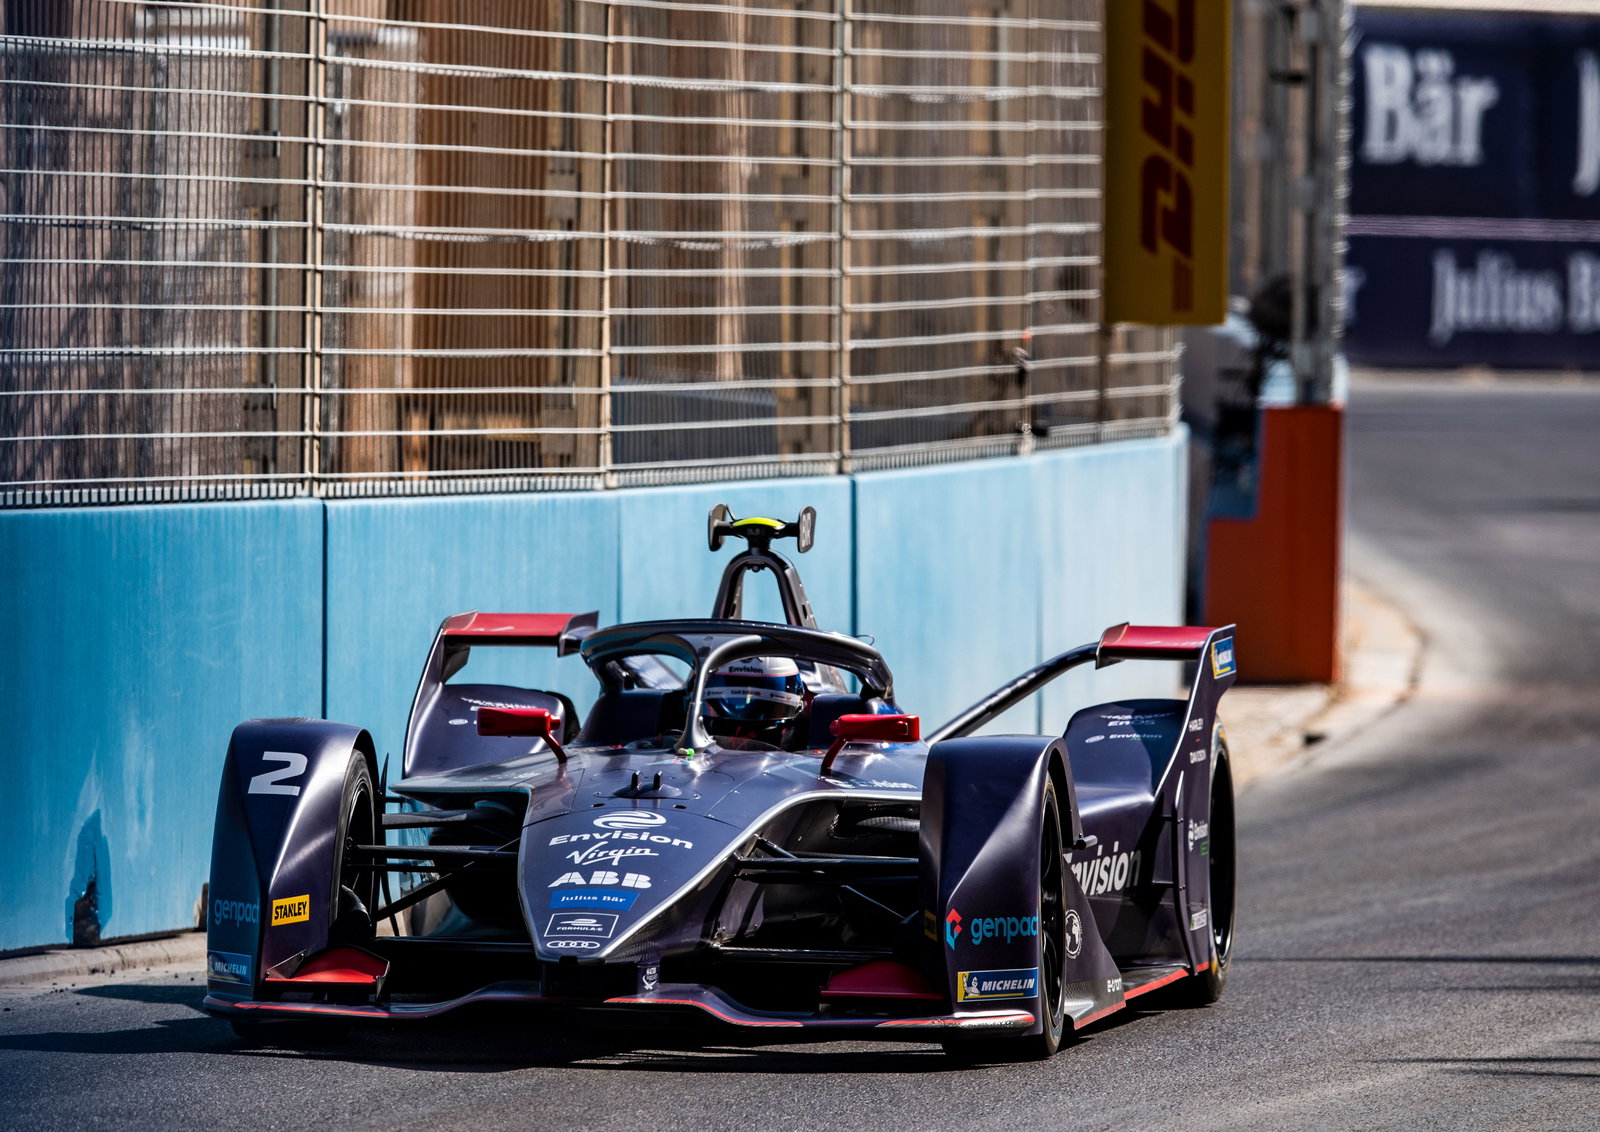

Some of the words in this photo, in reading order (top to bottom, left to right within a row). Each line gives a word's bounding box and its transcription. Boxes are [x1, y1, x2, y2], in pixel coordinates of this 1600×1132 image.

[1362, 42, 1498, 166] Bär
[1140, 0, 1194, 260] DHL
[1431, 250, 1562, 346] Julius
[729, 666, 763, 674] Envision
[248, 751, 308, 796] 2
[549, 830, 693, 849] Envision
[566, 841, 659, 866] Virgin
[1063, 841, 1141, 896] nvision
[548, 871, 652, 888] ABB
[603, 895, 626, 903] Bär
[274, 901, 308, 920] STANLEY
[214, 961, 248, 976] MICHELIN
[981, 978, 1035, 991] MICHELIN
